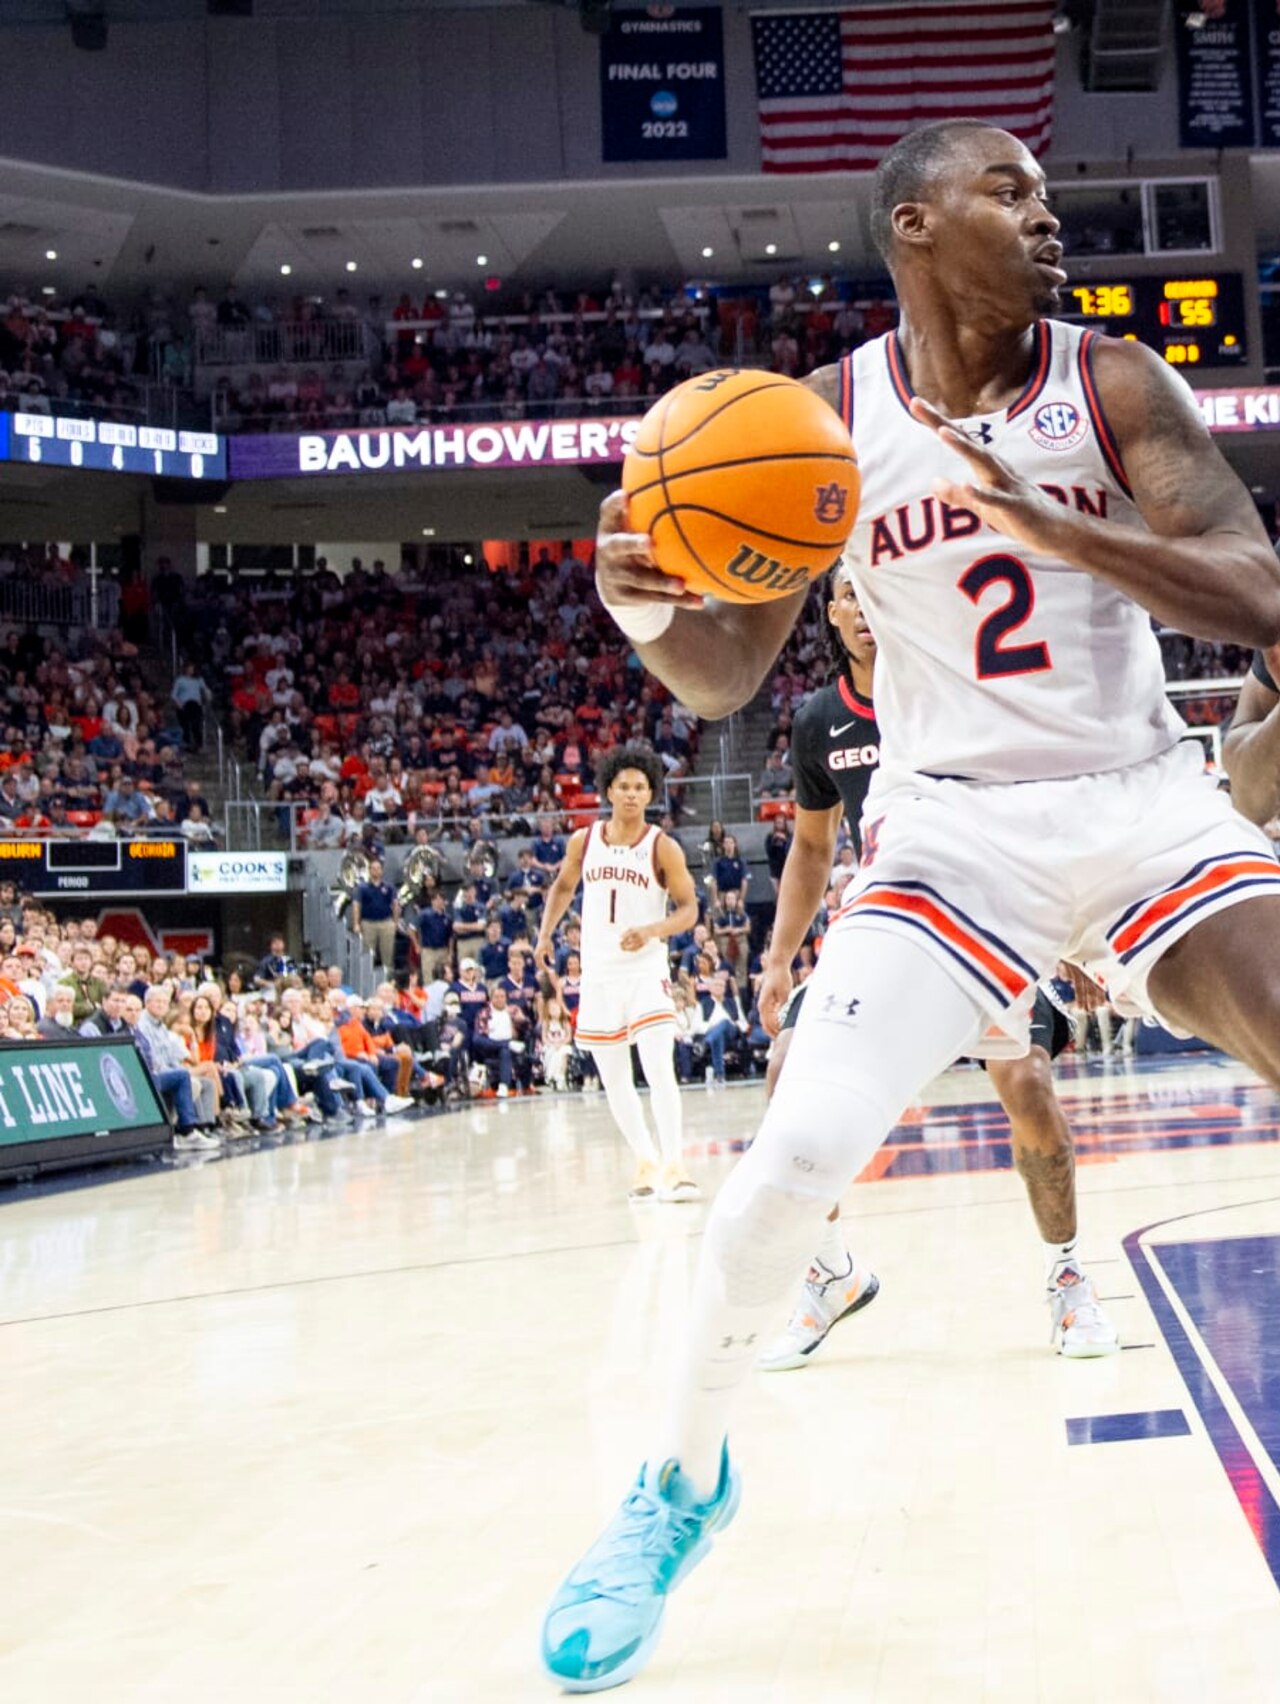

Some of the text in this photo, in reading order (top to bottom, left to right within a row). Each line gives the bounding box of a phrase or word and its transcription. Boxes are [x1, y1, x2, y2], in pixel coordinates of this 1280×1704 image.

[621, 20, 702, 33] GYMNASTICS
[608, 61, 717, 80] FINAL FOUR
[641, 121, 688, 138] 2022
[1073, 286, 1132, 316] 7:36
[1180, 299, 1214, 326] 55
[1036, 403, 1079, 438] SEC
[1199, 395, 1239, 426] HE
[112, 445, 123, 469] 4
[300, 420, 641, 472] BAUMHOWER'S
[154, 450, 162, 473] 1
[870, 483, 1108, 567] AUBN
[727, 543, 809, 591] Wil
[957, 552, 1053, 680] 2
[828, 744, 879, 770] GEO
[58, 876, 90, 888] PERIOD
[219, 862, 284, 875] COOK'S
[610, 888, 617, 925] 1
[11, 1061, 97, 1124] LINE
